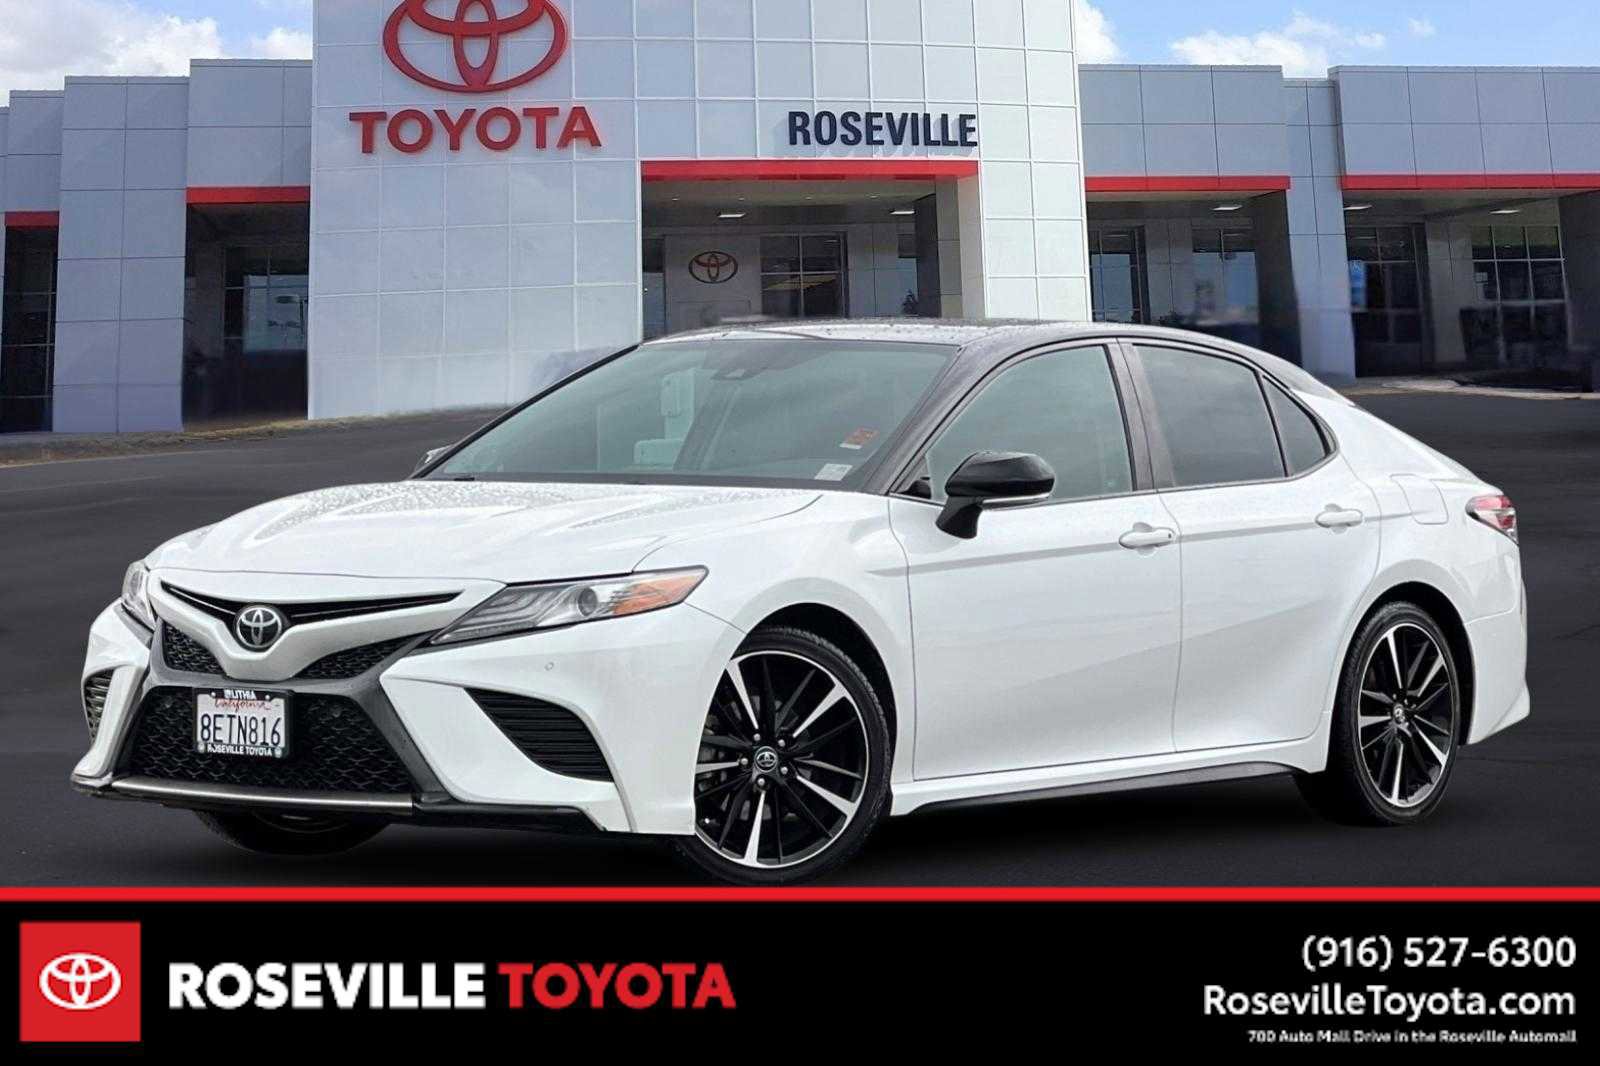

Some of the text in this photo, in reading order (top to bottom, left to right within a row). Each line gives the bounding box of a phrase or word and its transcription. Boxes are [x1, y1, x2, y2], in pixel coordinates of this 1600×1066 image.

[349, 106, 603, 154] TOYOTA
[788, 110, 979, 148] ROSEVILLE
[232, 689, 257, 700] LITHIA
[200, 713, 282, 747] 8ETN816
[206, 743, 273, 757] ROSEVILLE TOYOTA
